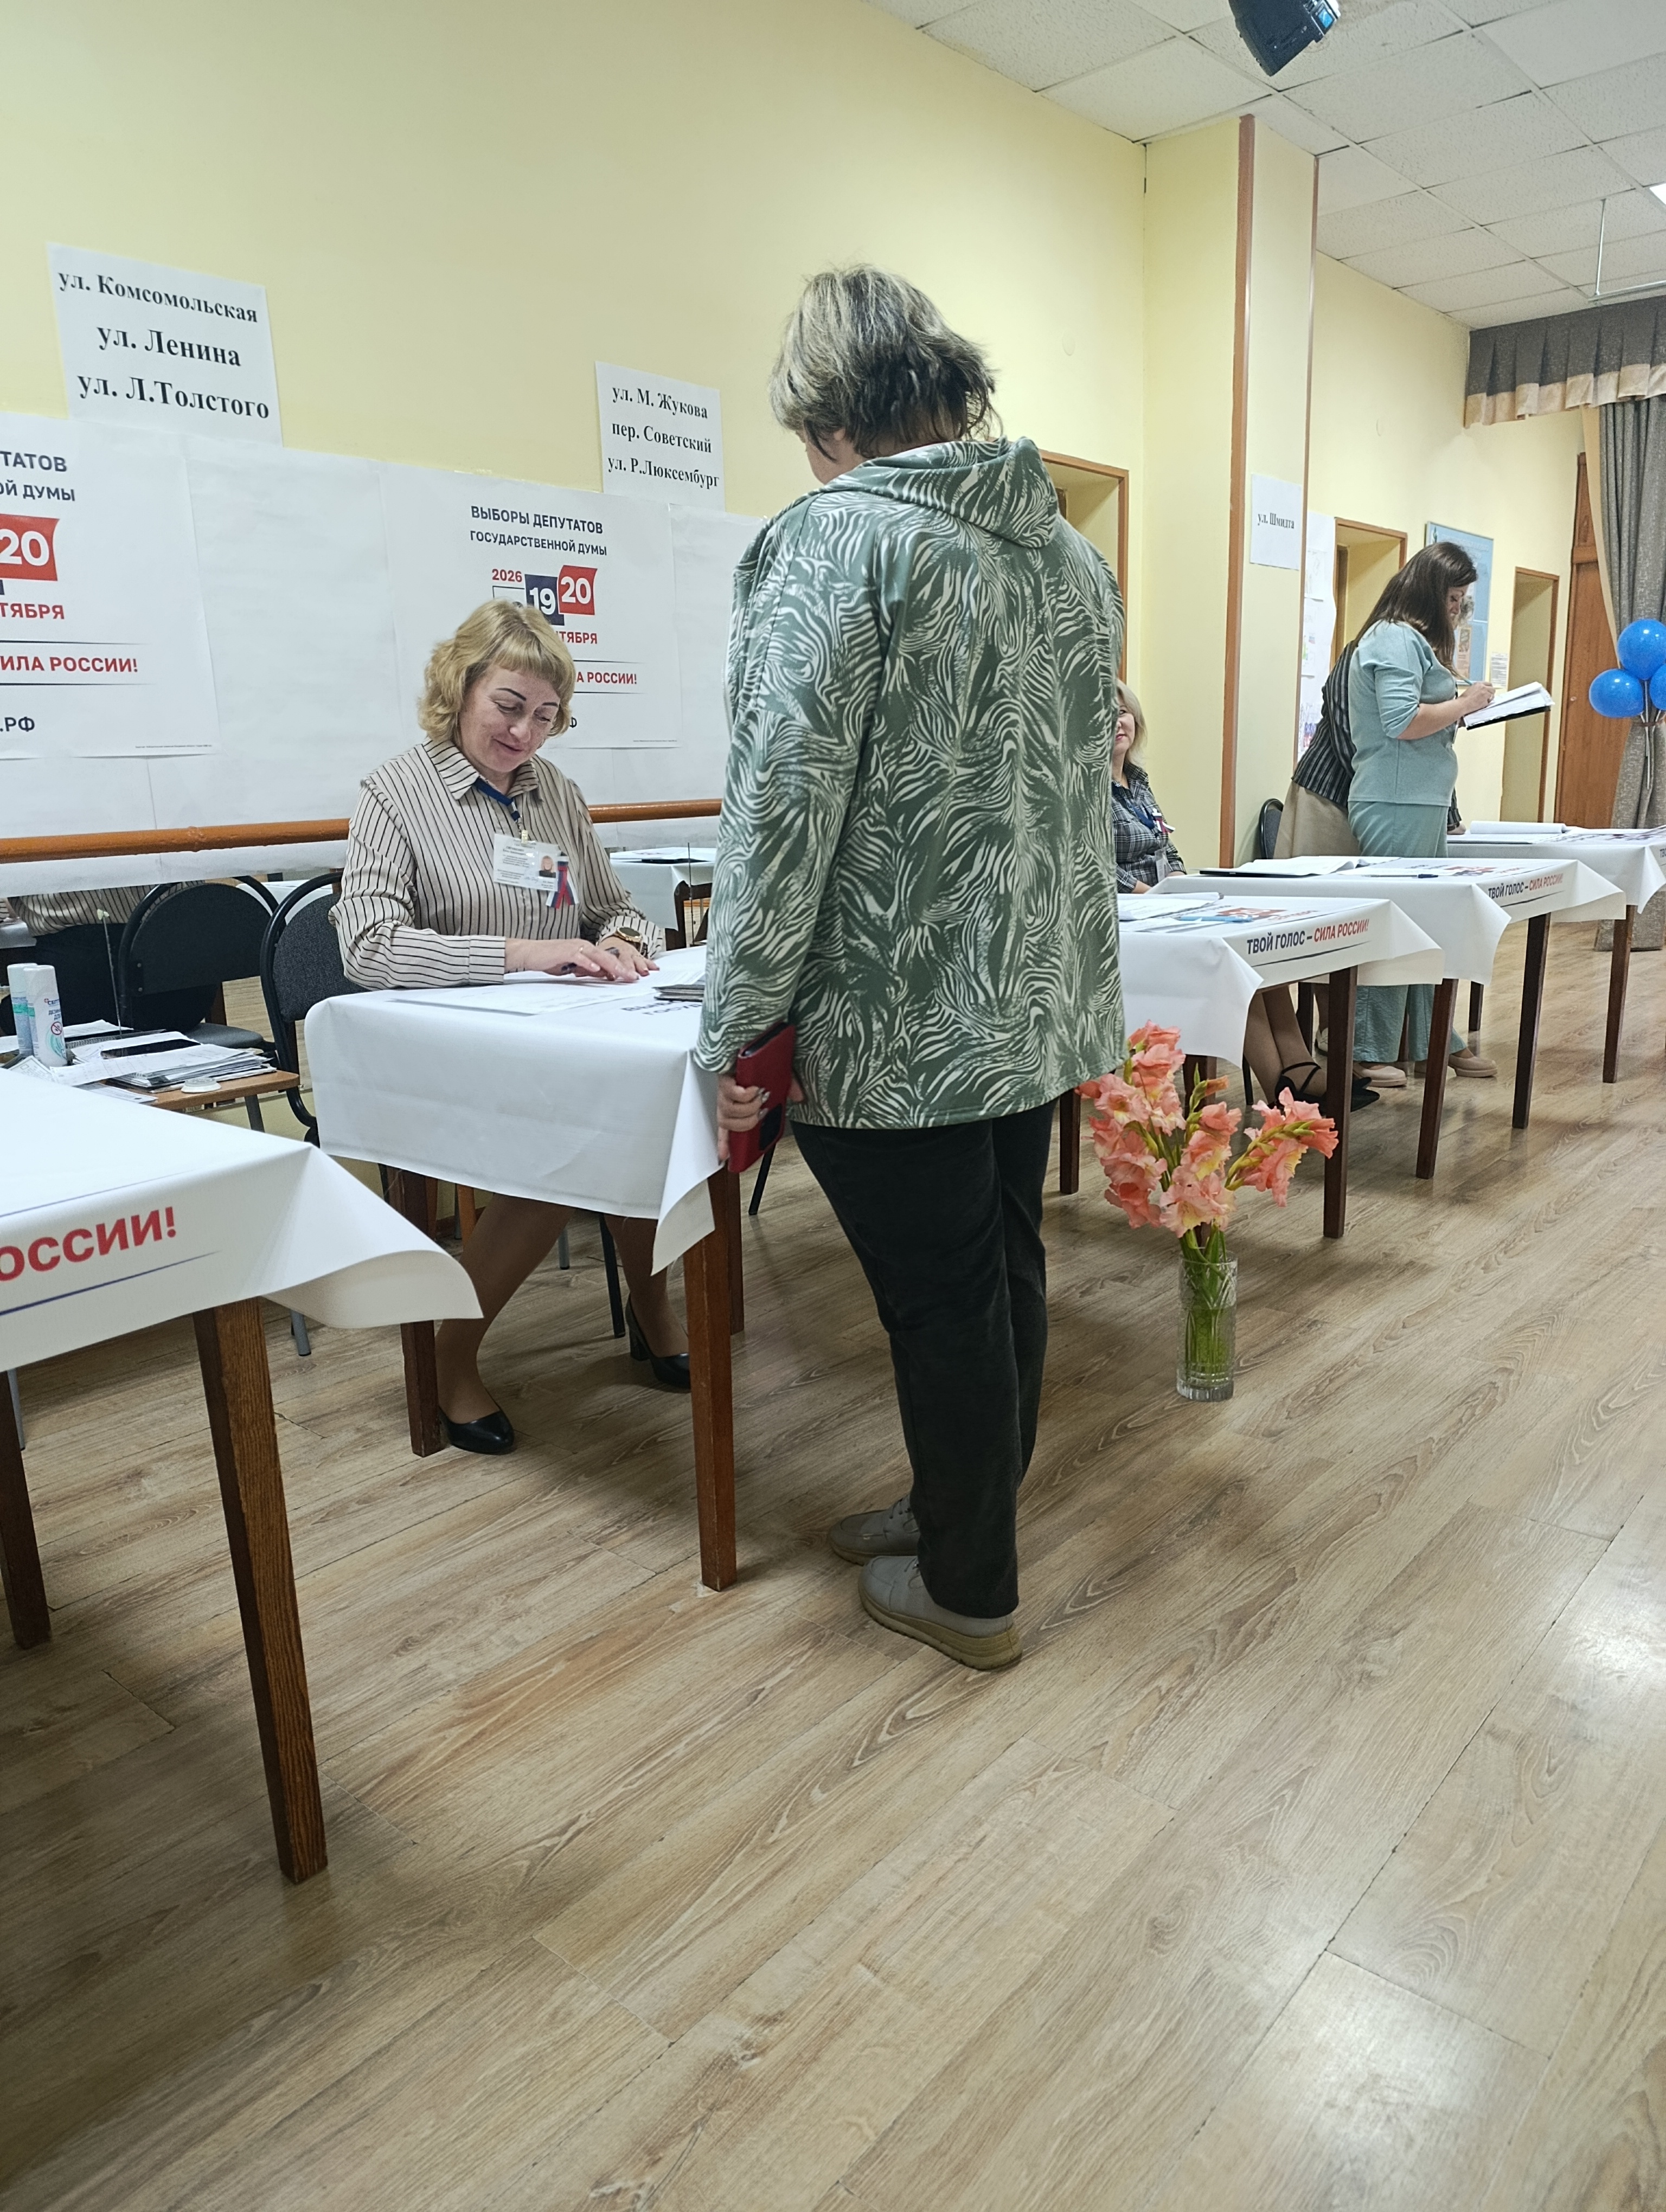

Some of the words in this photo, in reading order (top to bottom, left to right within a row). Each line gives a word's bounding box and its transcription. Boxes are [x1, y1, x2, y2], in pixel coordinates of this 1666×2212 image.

[58, 272, 91, 292] ул.
[97, 274, 258, 323] Комсомольская
[97, 326, 137, 350] ул.
[144, 329, 241, 367] Ленина
[77, 375, 118, 398] ул.
[126, 377, 270, 419] Л.Толстого
[612, 387, 633, 403] ул.
[637, 388, 654, 407] М.
[657, 393, 708, 419] Жукова
[612, 423, 639, 442] пер.
[644, 425, 712, 453] Советский
[608, 457, 626, 473] ул.
[631, 458, 720, 490] Р.Люксембург
[23, 484, 75, 501] ДУМЫ
[471, 505, 529, 525] ВЫБОРЫ
[533, 513, 603, 534] ДЕПУТАТОВ
[1258, 513, 1268, 526] ул.
[1270, 512, 1294, 529] Шмидта
[0, 529, 49, 566] 20
[470, 530, 575, 552] ГОСУДАРСТВЕННОЙ
[578, 543, 607, 556] ДУМЫ
[492, 568, 522, 583] 2026
[529, 587, 556, 615] 19
[560, 576, 591, 604] 20
[556, 631, 597, 644] ТЯБРЯ
[49, 657, 138, 673] РОССИИ!
[587, 672, 637, 685] РОССИИ!
[1488, 883, 1504, 899] ТВОЙ
[1505, 882, 1524, 896] ГОЛОС
[1529, 878, 1543, 891] СИЛА
[1247, 932, 1273, 955] ТВОЙ
[1275, 930, 1305, 949] ГОЛОС
[1314, 925, 1335, 942] СИЛА
[1337, 918, 1369, 938] РОССИИ!
